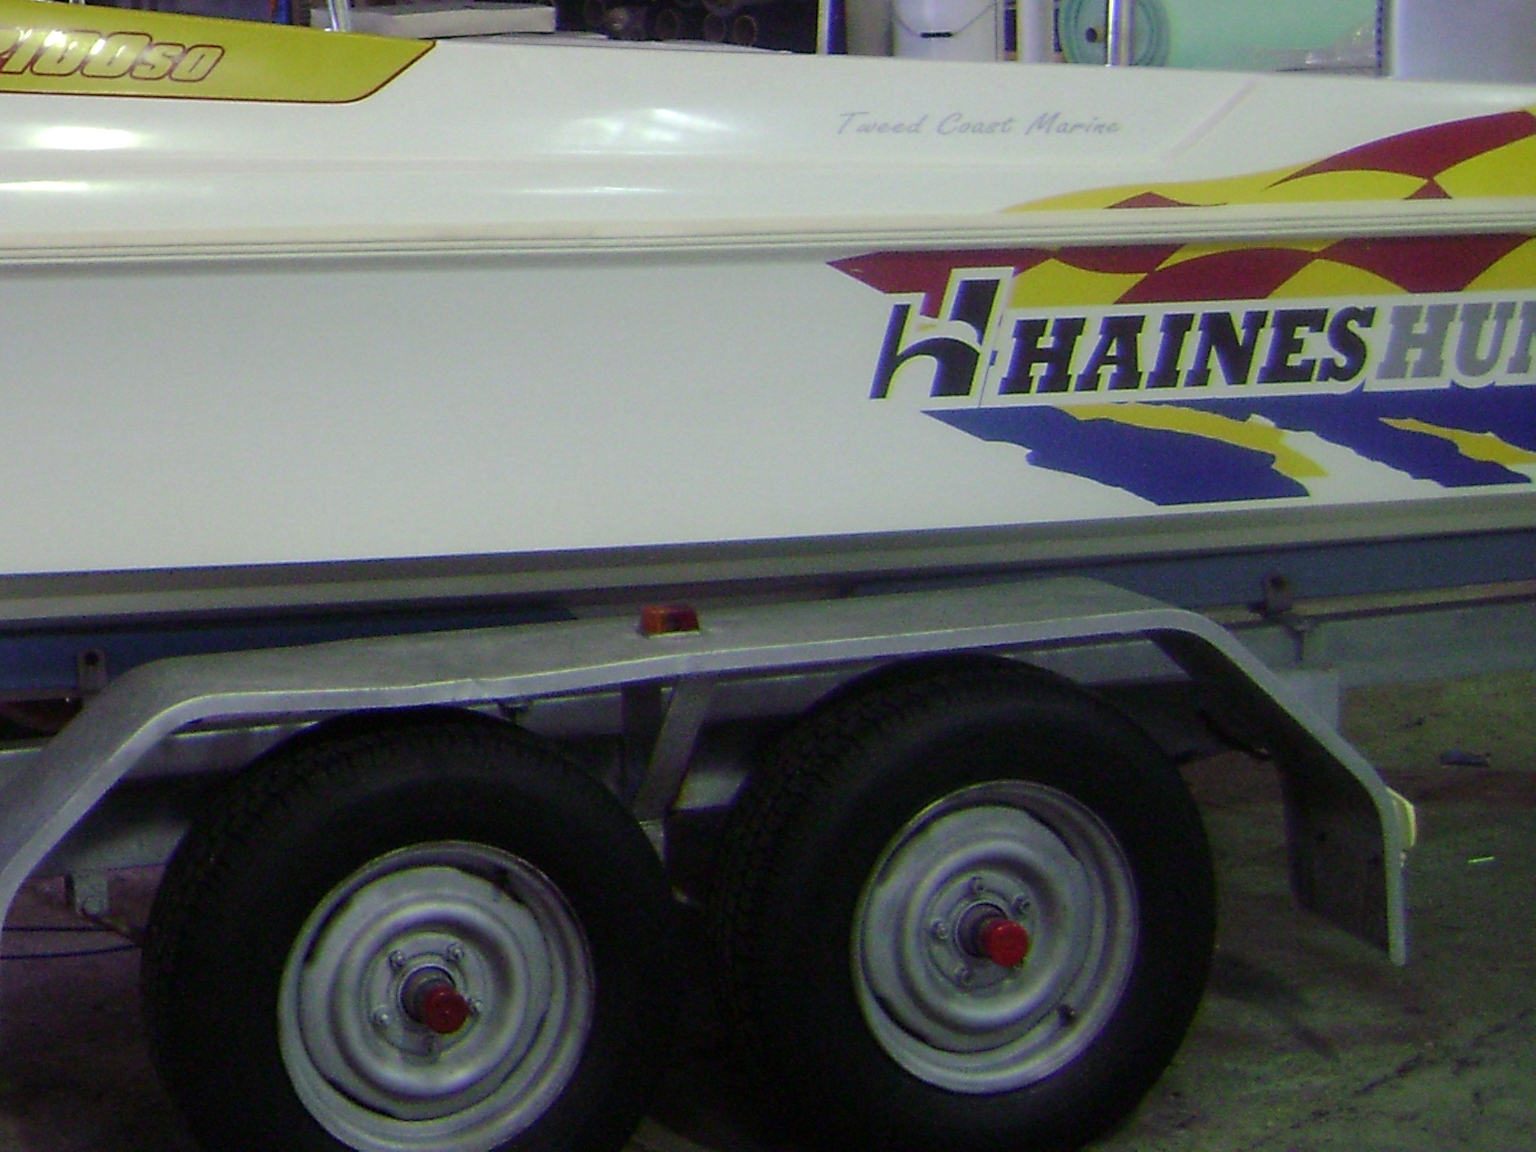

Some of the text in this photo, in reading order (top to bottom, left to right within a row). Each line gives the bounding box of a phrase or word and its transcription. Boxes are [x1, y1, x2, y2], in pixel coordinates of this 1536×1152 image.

[837, 111, 1123, 136] Tweed Coast Marine
[998, 306, 1375, 396] HAINES
